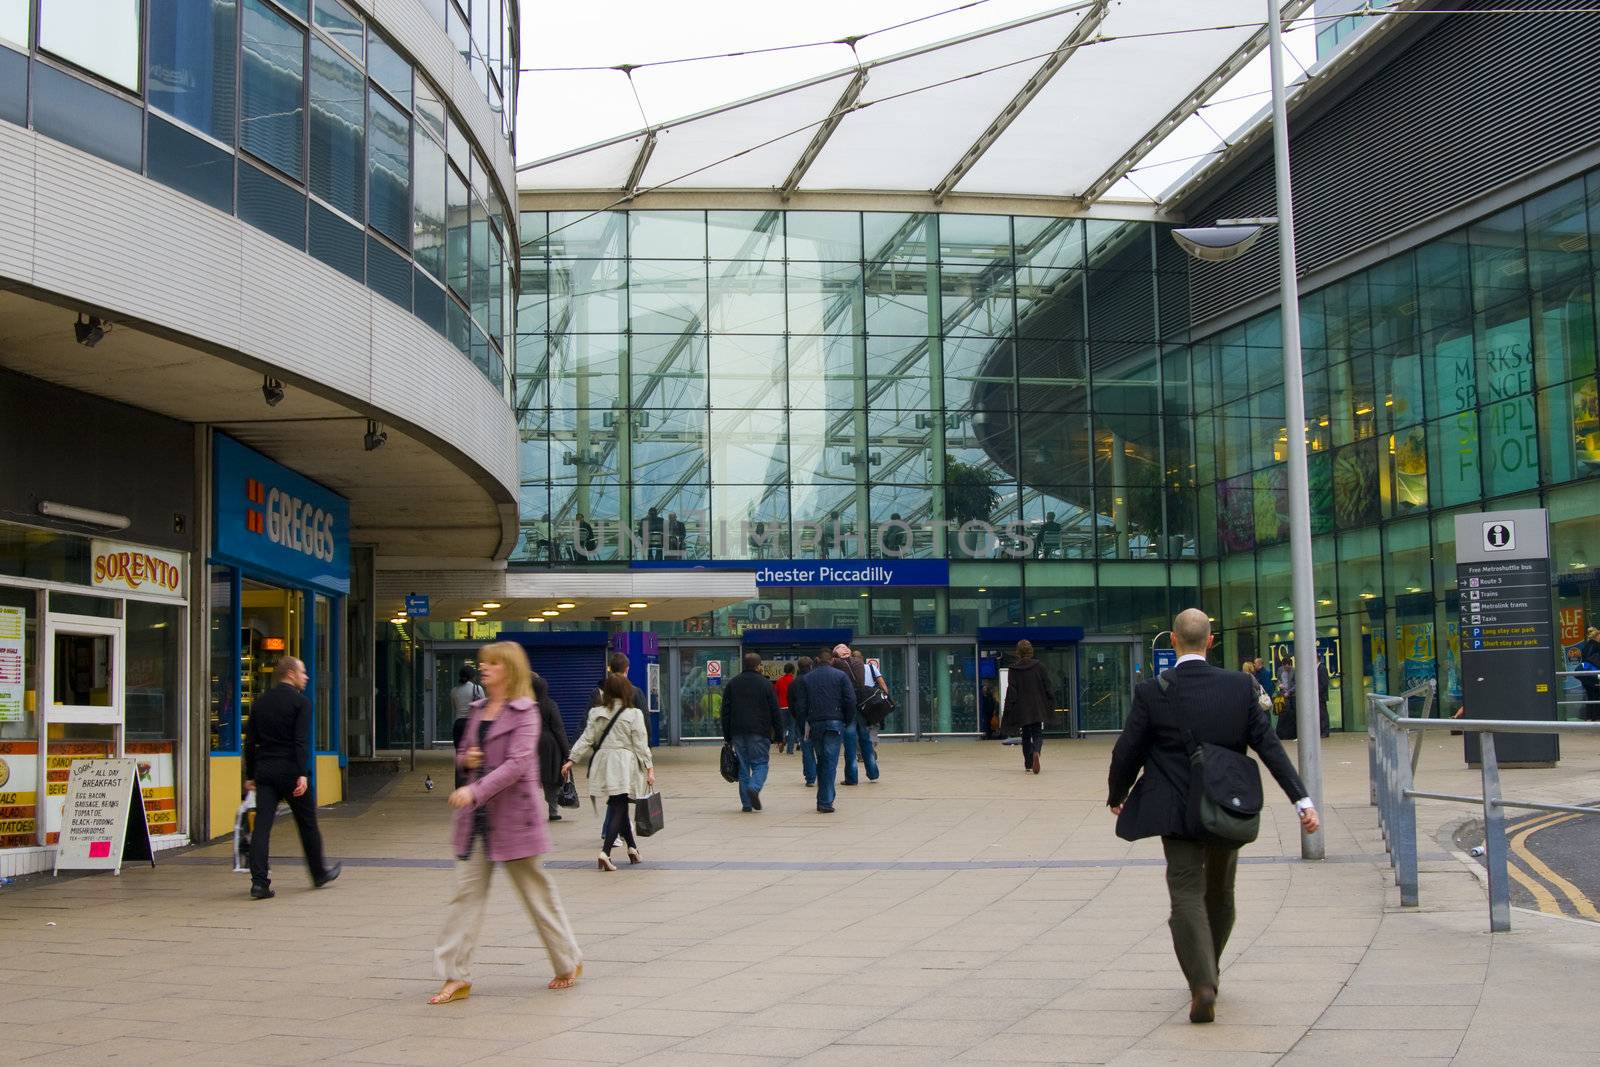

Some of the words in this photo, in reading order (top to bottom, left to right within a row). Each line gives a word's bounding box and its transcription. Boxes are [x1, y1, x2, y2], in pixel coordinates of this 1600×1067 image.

[1454, 344, 1522, 383] MRKS
[1455, 368, 1533, 411] SPNCE
[266, 487, 334, 562] GREGGS
[94, 551, 180, 591] SORENTO
[1482, 564, 1520, 572] Metroshuttle
[755, 567, 815, 582] chester
[820, 567, 893, 584] Piccadilly
[1521, 626, 1536, 634] park
[1413, 632, 1432, 658] £1
[1524, 639, 1538, 647] park
[73, 760, 94, 776] LOOK!
[108, 769, 120, 777] DAY
[82, 778, 122, 788] BREAKFAST
[0, 820, 34, 833] TATOES
[70, 827, 106, 835] MUSHROOMS
